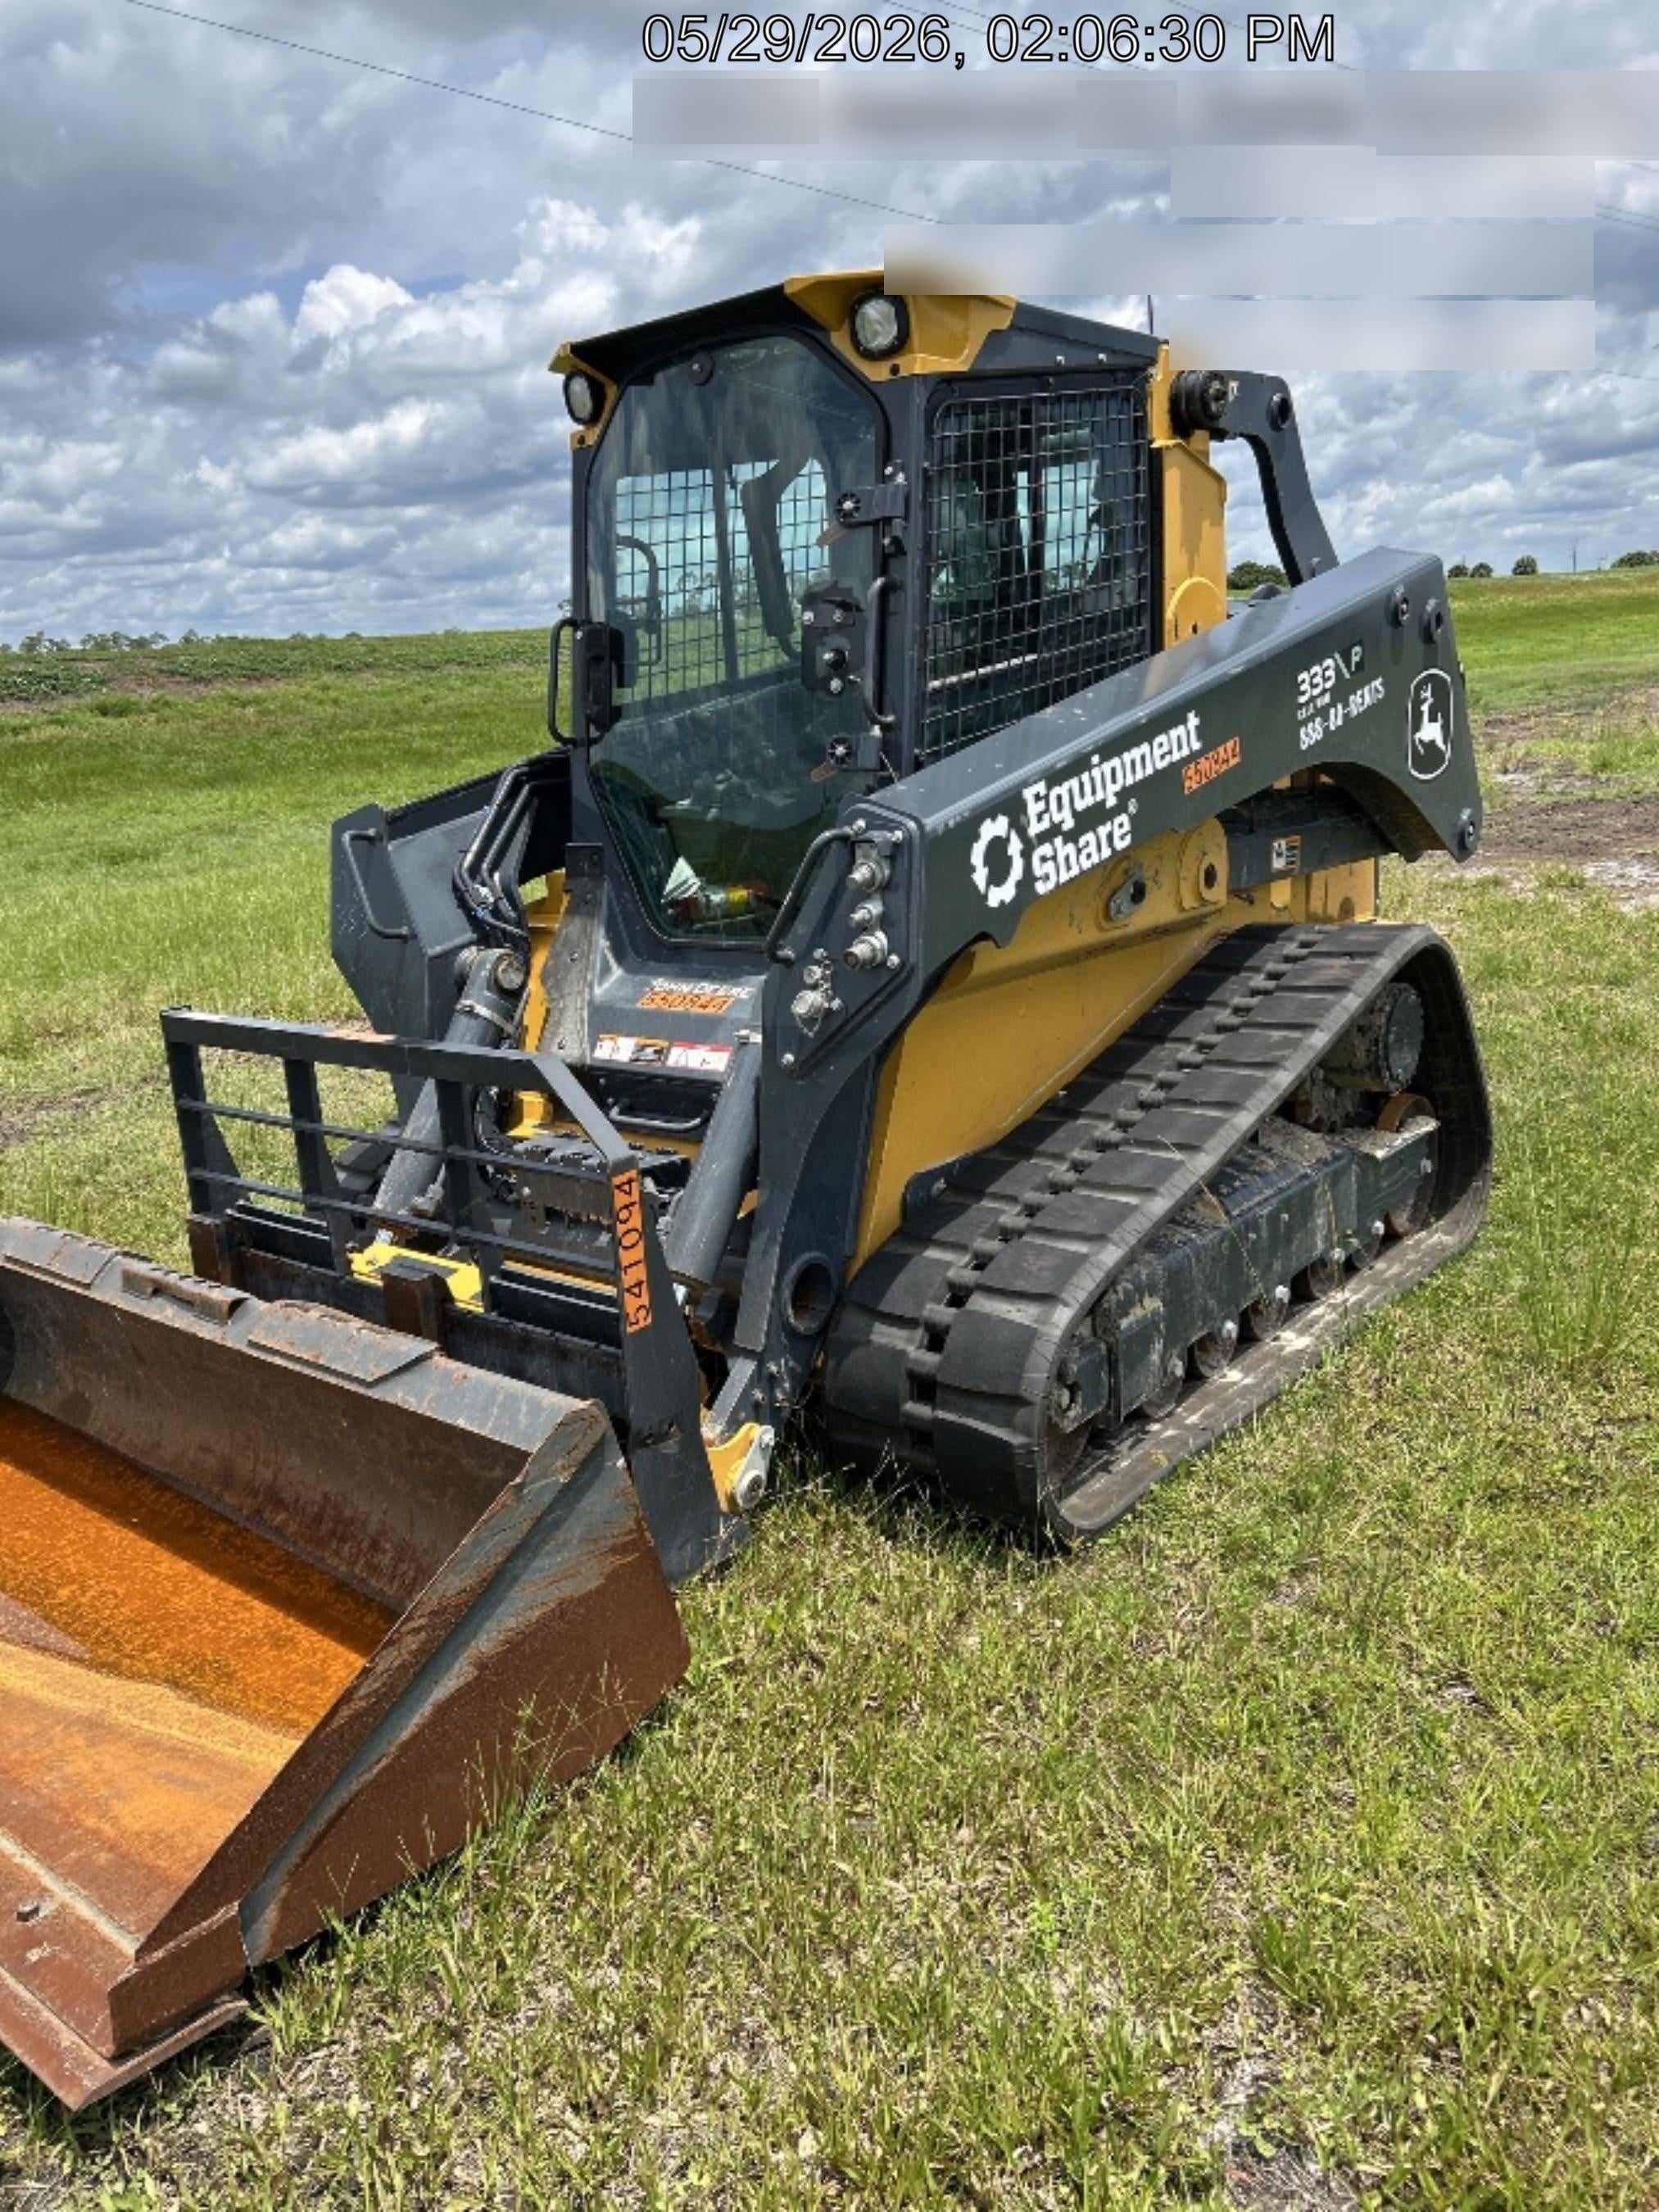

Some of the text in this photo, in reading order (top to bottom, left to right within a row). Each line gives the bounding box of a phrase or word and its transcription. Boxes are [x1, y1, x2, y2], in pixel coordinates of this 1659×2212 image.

[1297, 658, 1335, 703] 333
[1022, 709, 1203, 837] Equipment
[614, 1177, 650, 1326] 541094
